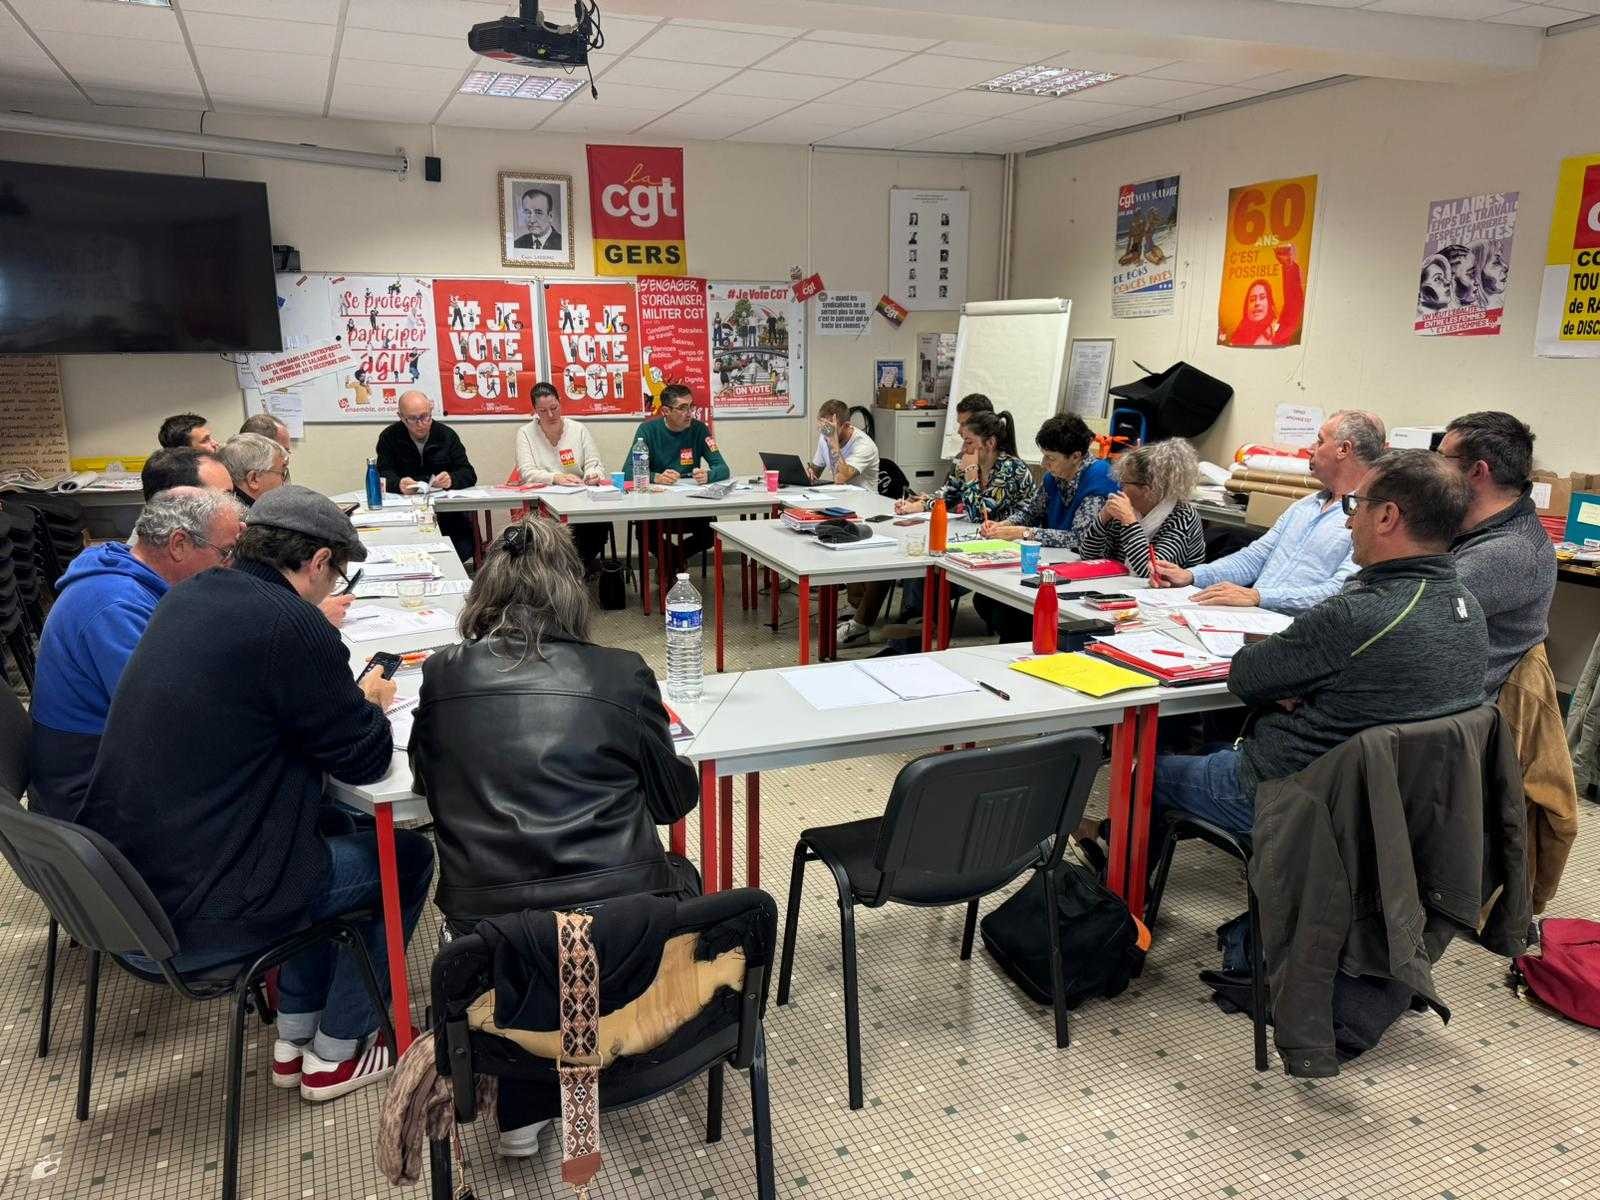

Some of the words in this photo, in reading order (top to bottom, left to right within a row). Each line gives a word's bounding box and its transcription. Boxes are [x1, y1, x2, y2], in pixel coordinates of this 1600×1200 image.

[602, 177, 677, 228] cgt
[1119, 191, 1135, 209] cgt
[1432, 192, 1505, 221] SALAIRES
[1233, 183, 1306, 246] 60
[1459, 211, 1473, 224] DE
[1255, 234, 1280, 248] ANS
[604, 245, 681, 265] GERS
[1230, 249, 1259, 265] C'EST
[1228, 263, 1280, 280] POSSIBLE
[640, 278, 699, 293] S'ENGAGER,
[802, 282, 817, 295] cgt
[343, 291, 360, 309] Se
[1569, 298, 1584, 314] de
[448, 300, 480, 331] #
[486, 302, 522, 332] JE
[559, 303, 590, 334] #
[595, 304, 627, 334] JE
[642, 308, 681, 320] MILITER
[684, 308, 705, 320] CGT
[884, 305, 899, 320] cgt
[348, 323, 426, 346] participer
[1563, 320, 1575, 336] de
[448, 331, 522, 361] VOTE
[560, 334, 629, 363] VOTE
[453, 362, 523, 399] CGT
[563, 363, 629, 400] CGT
[735, 386, 747, 395] ON
[749, 385, 771, 394] VOTE
